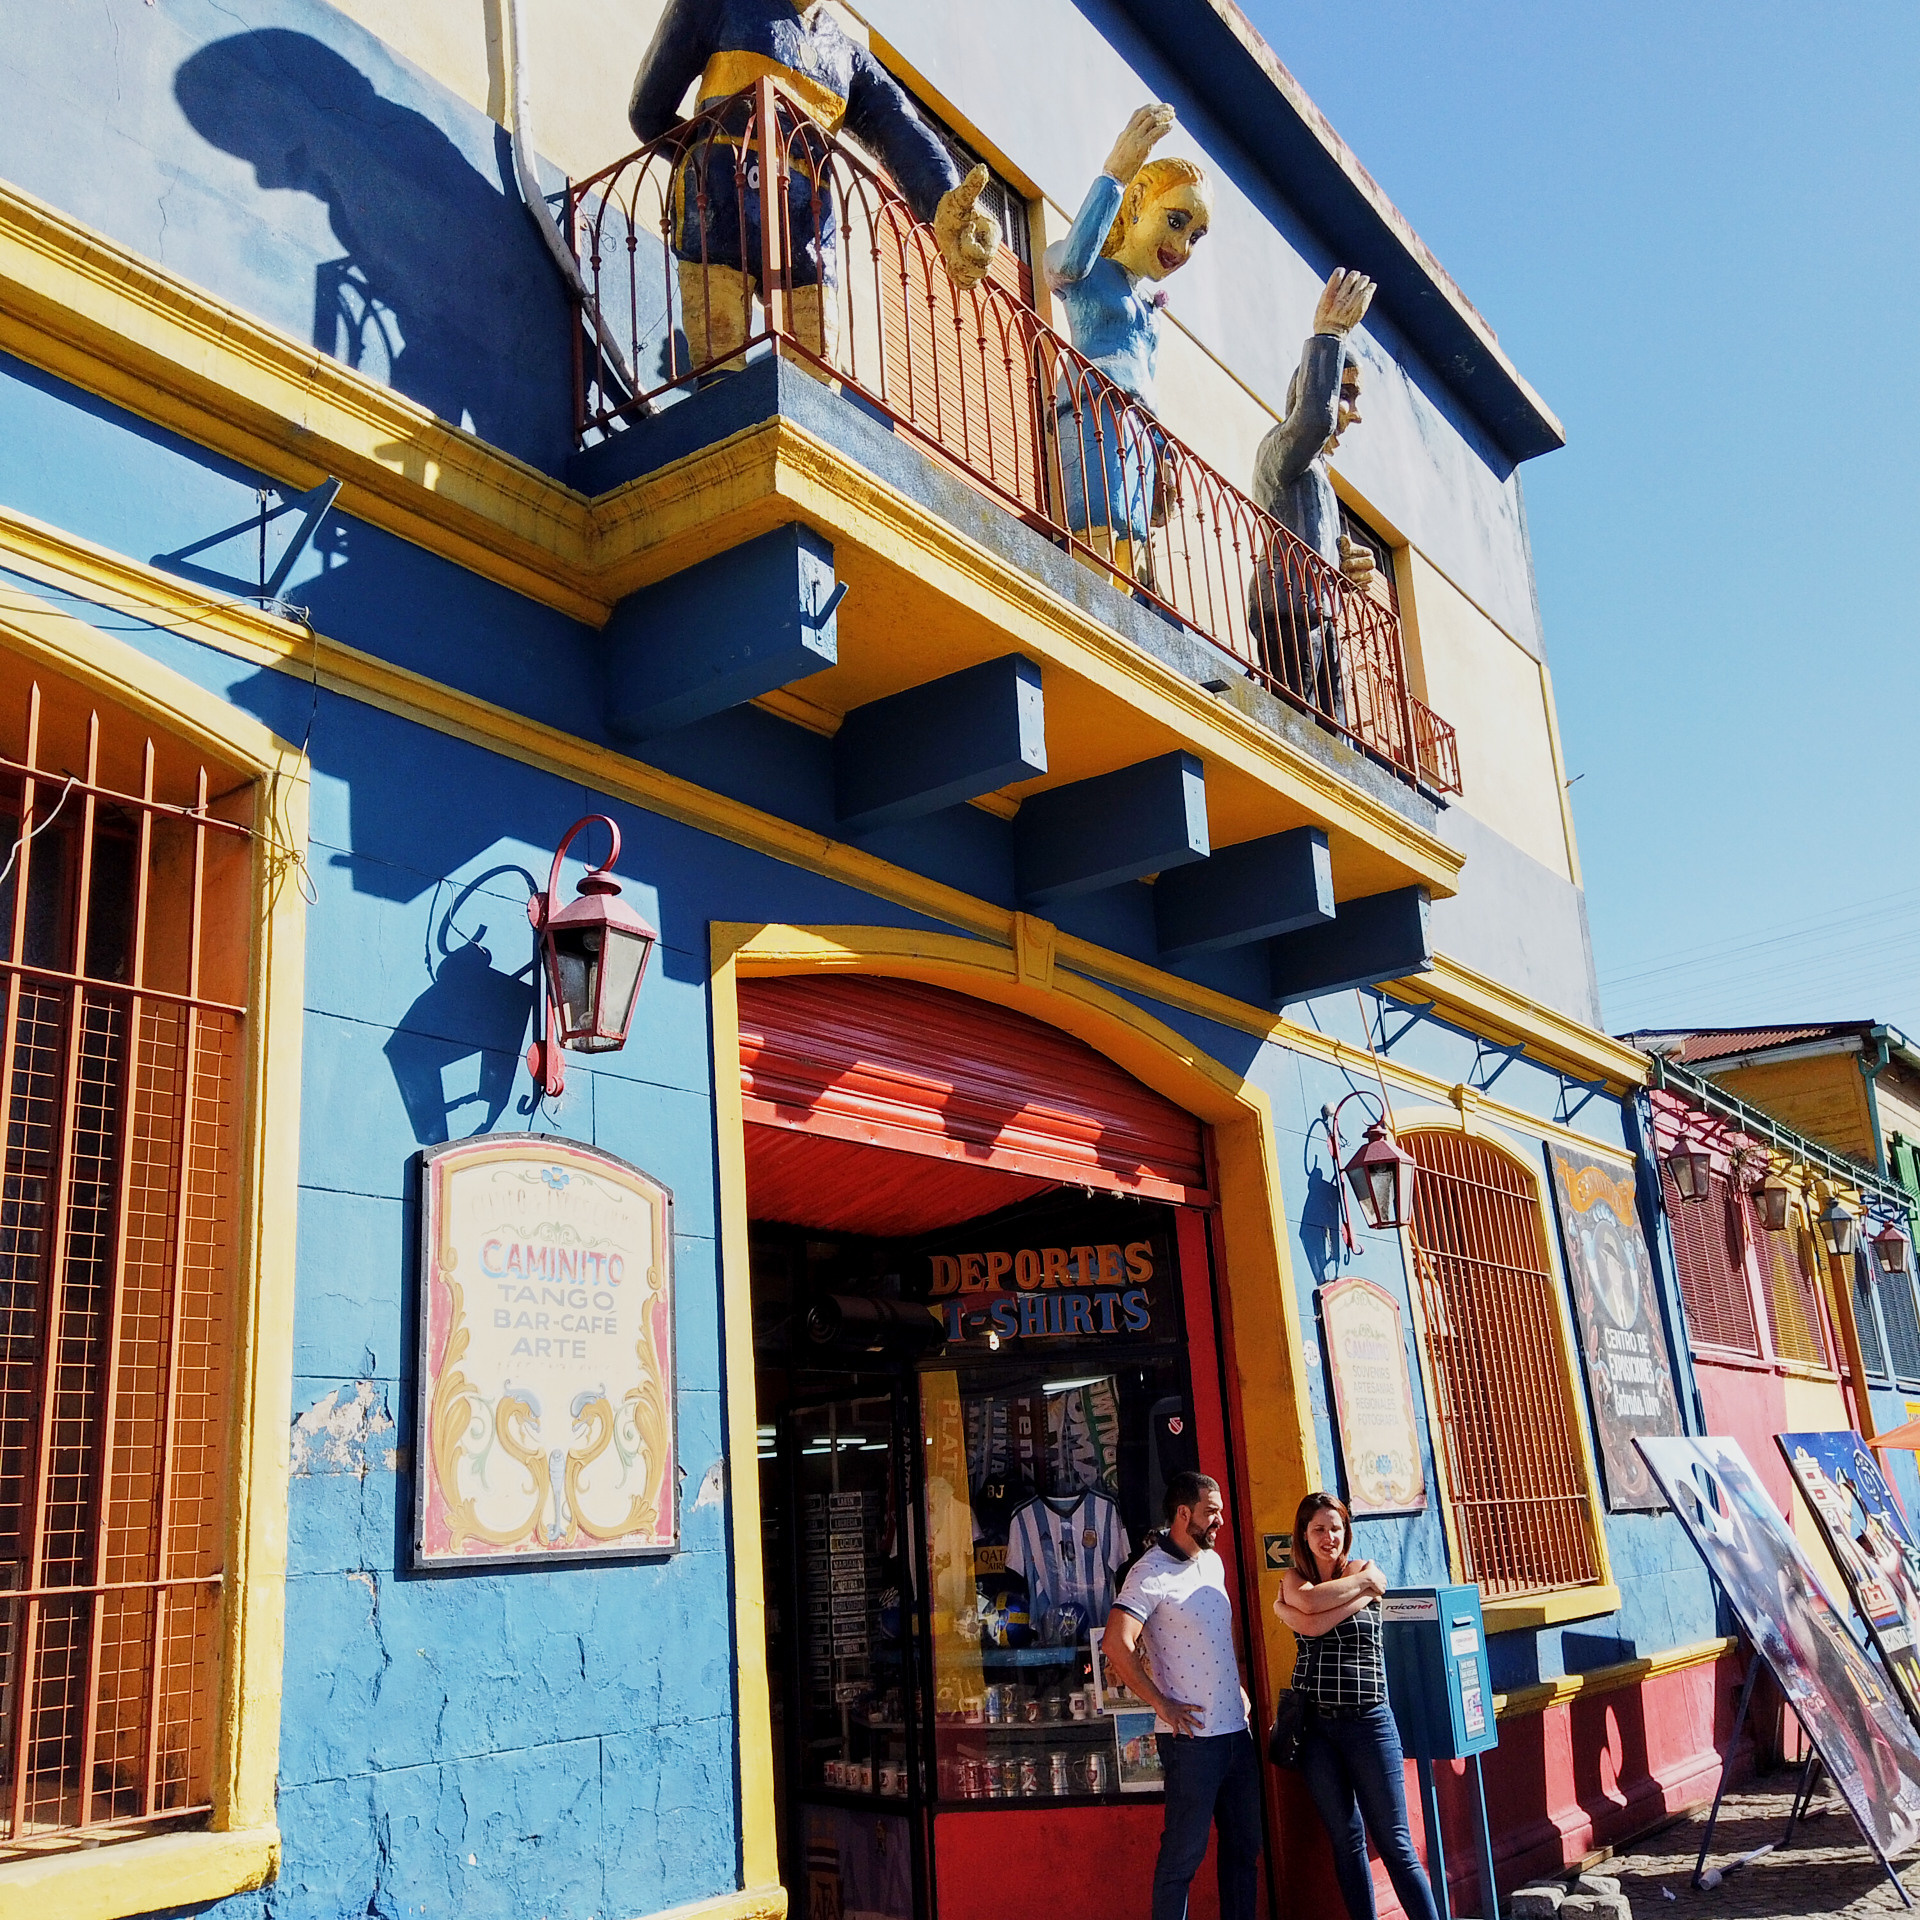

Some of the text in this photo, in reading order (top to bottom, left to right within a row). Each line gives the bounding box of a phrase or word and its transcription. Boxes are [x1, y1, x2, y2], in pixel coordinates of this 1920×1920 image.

[478, 1238, 625, 1287] CAMINITO
[928, 1240, 1155, 1296] DEPORTES
[497, 1284, 615, 1311] TANGO
[493, 1308, 618, 1335] BAR-CAFÉ
[943, 1288, 1152, 1343] T-SHIRTS
[510, 1337, 586, 1359] ARTE
[1604, 1327, 1650, 1354] CENTRO DE
[1352, 1365, 1391, 1380] SOUVENIRS
[1608, 1353, 1655, 1384] EXPOSICIONES
[1355, 1398, 1397, 1411] REGIONALES
[1385, 1603, 1433, 1611] raiconet
